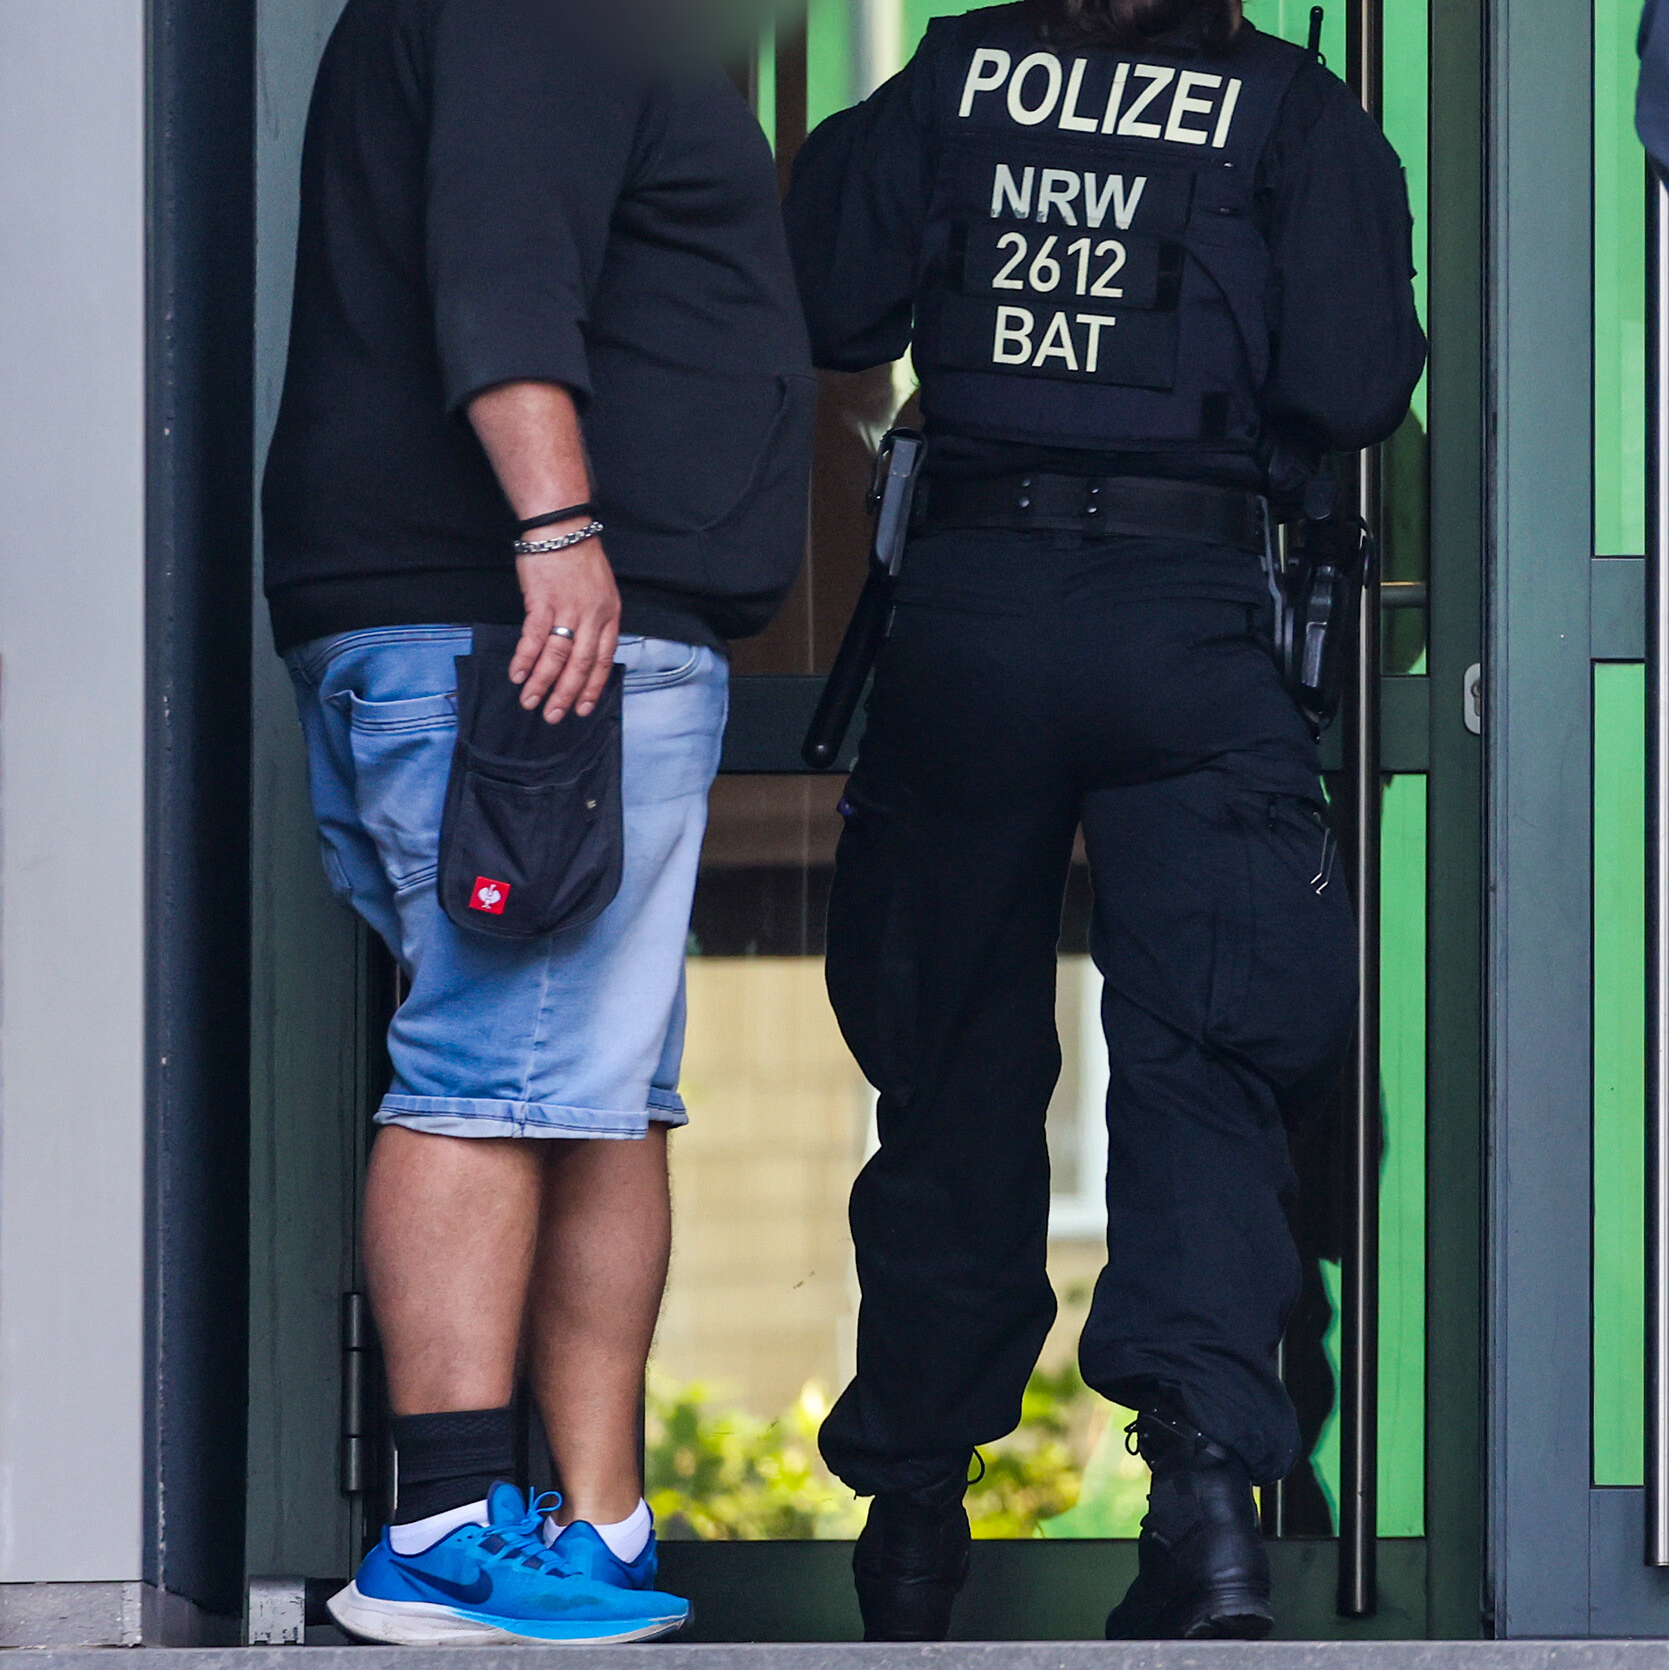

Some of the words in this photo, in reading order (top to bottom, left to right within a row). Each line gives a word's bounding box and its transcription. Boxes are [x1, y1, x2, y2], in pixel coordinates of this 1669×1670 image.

[958, 47, 1242, 148] POLIZEI
[990, 163, 1147, 230] NRW
[991, 232, 1127, 299] 2612
[992, 305, 1116, 373] BAT
